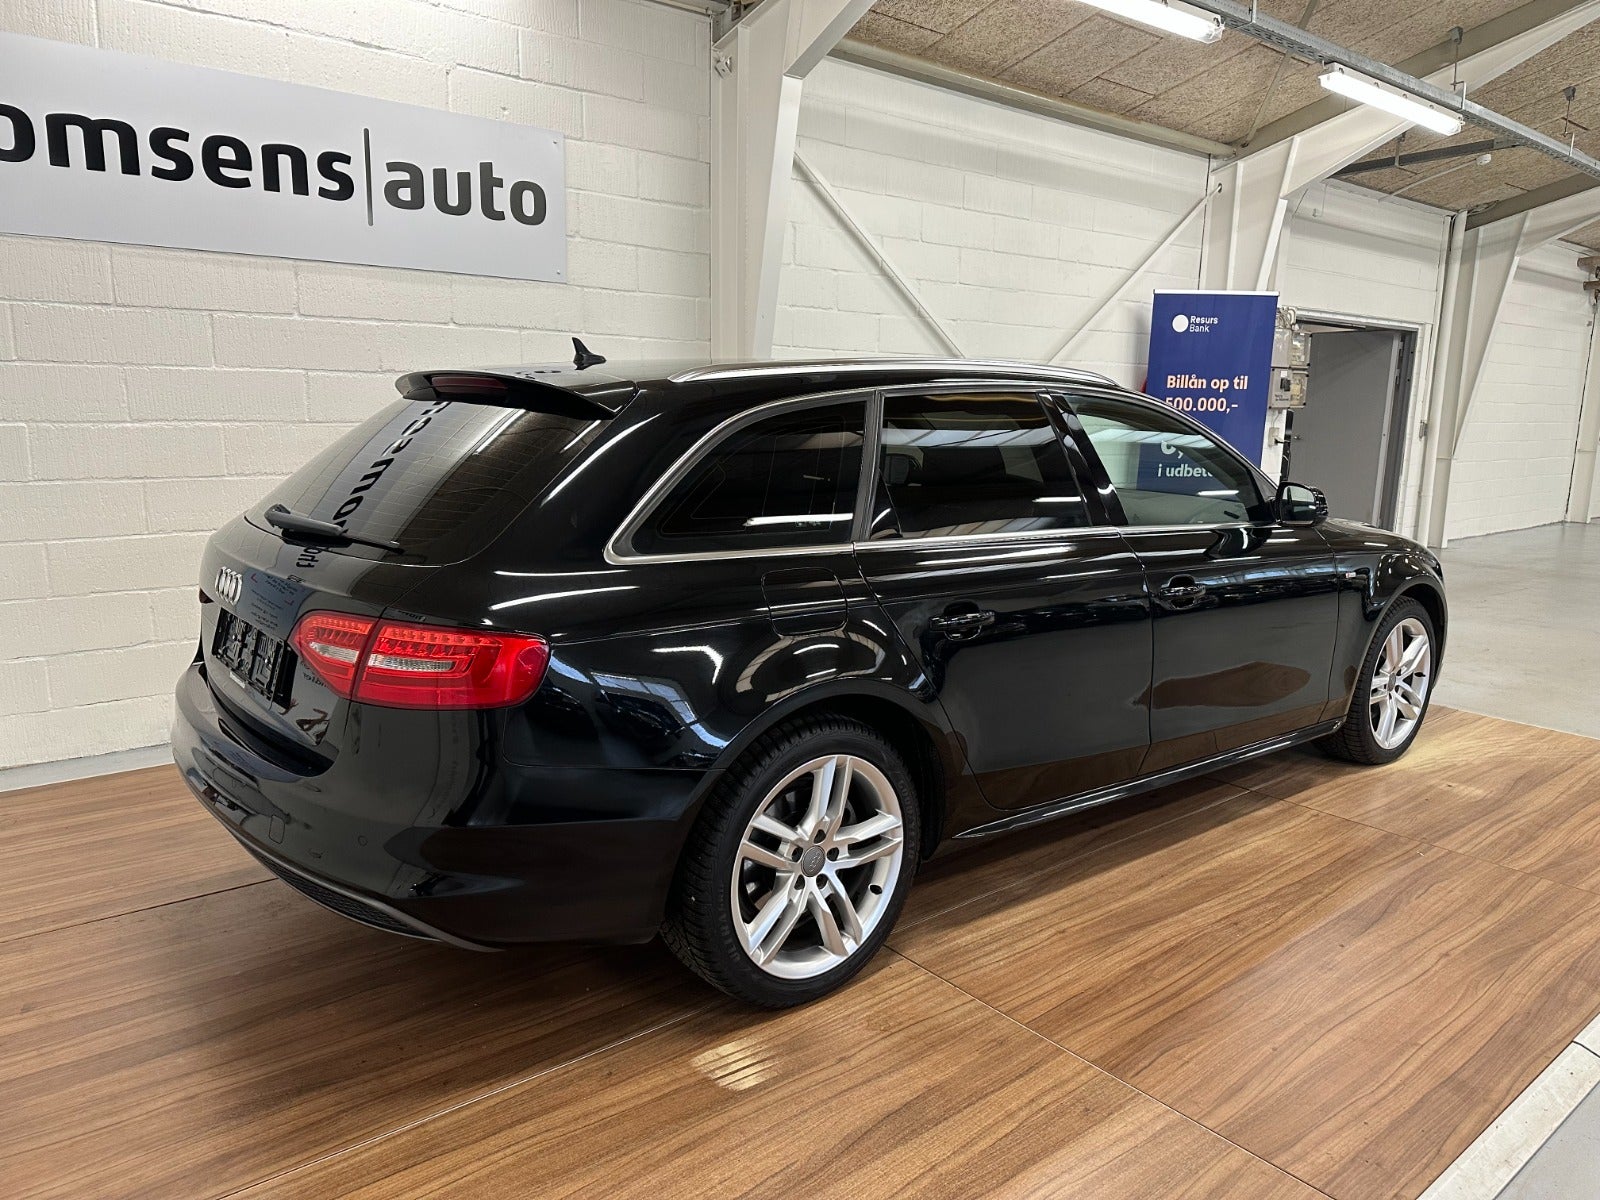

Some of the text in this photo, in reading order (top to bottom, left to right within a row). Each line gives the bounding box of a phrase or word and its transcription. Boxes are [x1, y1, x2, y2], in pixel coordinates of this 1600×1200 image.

[384, 161, 547, 226] auto
[1190, 315, 1219, 325] Resurs
[1189, 324, 1210, 333] Bank
[1166, 374, 1249, 393] Billån op til
[1157, 463, 1163, 477] i
